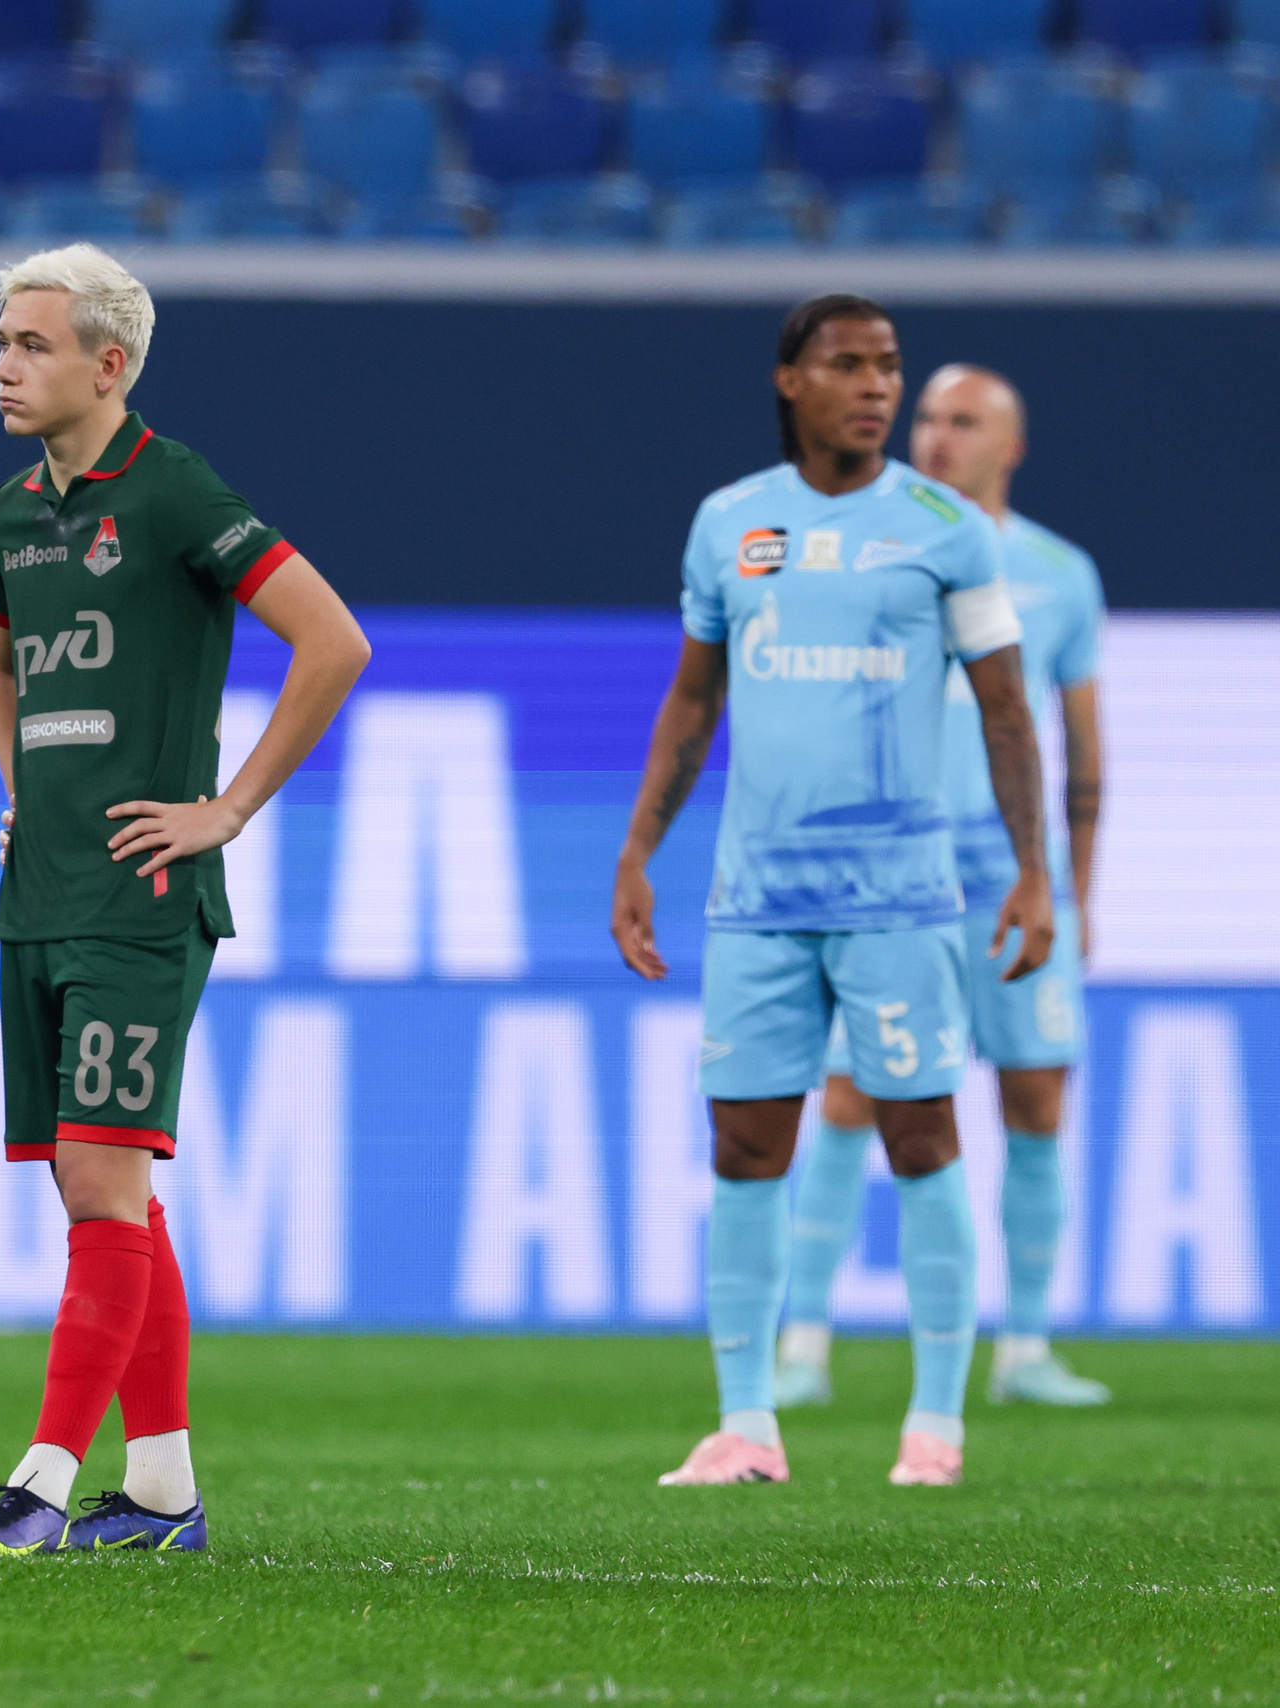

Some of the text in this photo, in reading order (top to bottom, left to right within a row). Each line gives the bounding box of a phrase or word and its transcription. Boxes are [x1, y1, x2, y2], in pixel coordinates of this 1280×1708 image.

[2, 544, 68, 572] BetBoom
[73, 1020, 159, 1111] 83
[876, 1000, 919, 1078] 5
